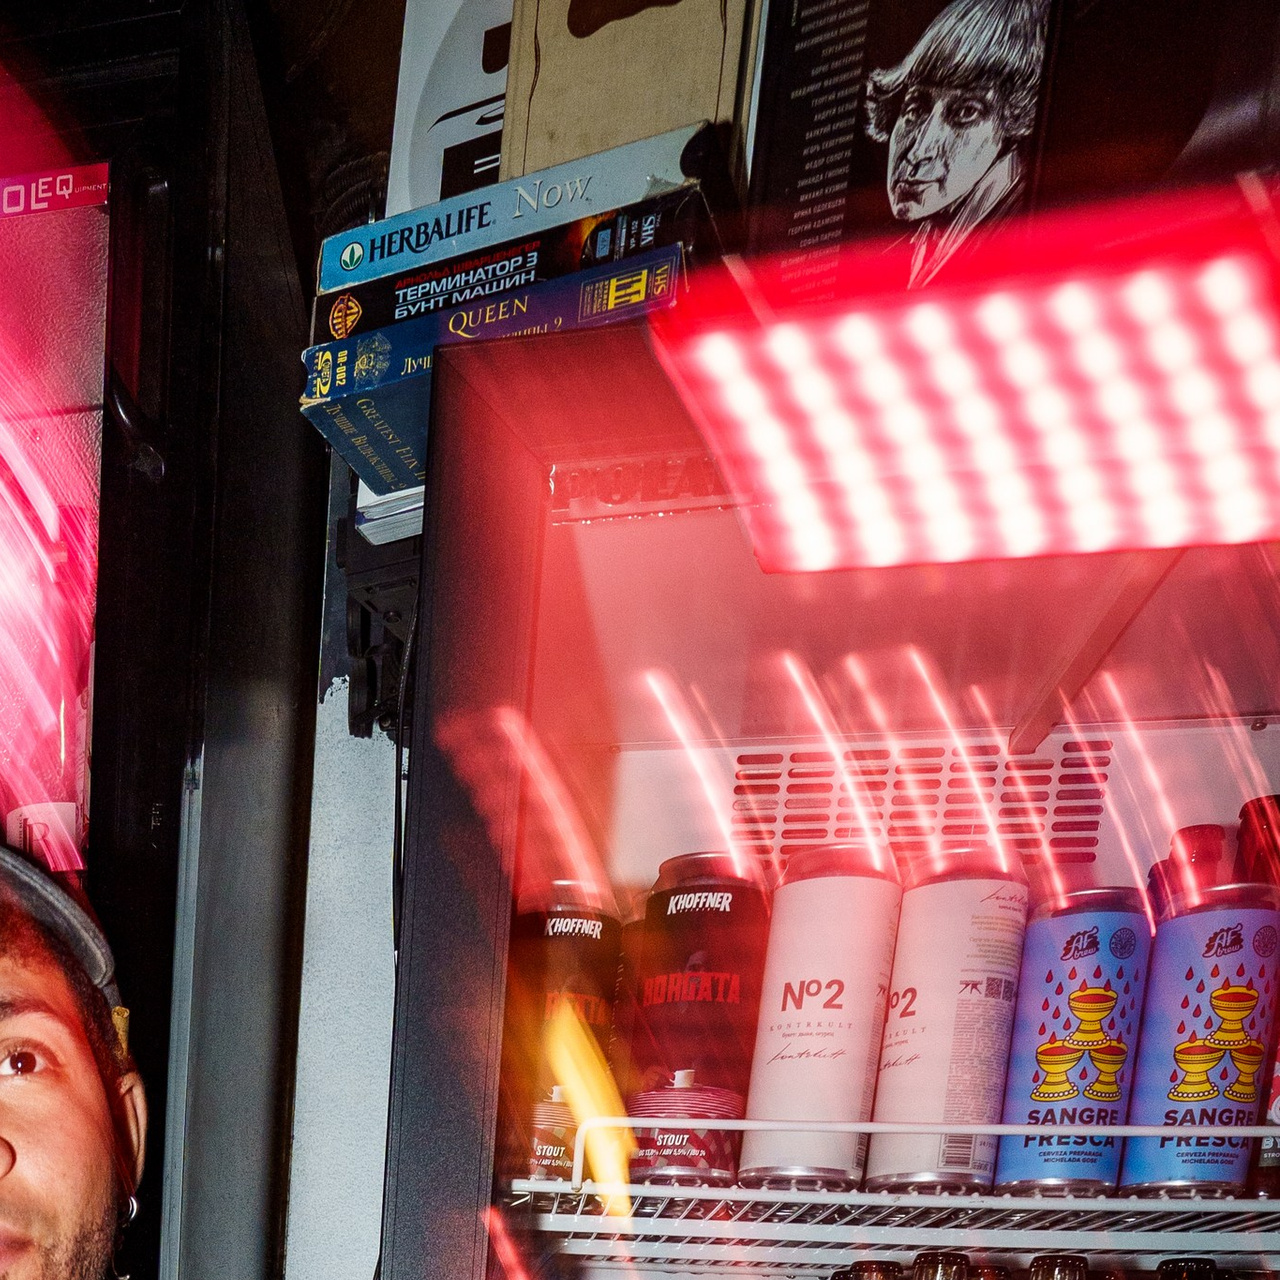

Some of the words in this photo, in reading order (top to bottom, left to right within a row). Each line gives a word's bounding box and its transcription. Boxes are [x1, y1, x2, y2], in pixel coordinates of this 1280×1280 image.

[370, 202, 492, 263] HERBALIFE
[640, 214, 656, 247] VHS
[395, 258, 522, 304] ТЕРМИНАТОР
[526, 251, 538, 268] 3
[395, 296, 450, 320] БУНТ
[452, 269, 535, 304] МАШИН
[448, 296, 528, 338] QUEEN
[667, 892, 733, 914] KHOFFNER
[544, 918, 603, 940] KHOFFNER
[1026, 1107, 1118, 1125] SANGRE
[1163, 1108, 1254, 1126] SANGRE
[536, 1145, 565, 1157] STOUT
[657, 1134, 689, 1146] STOUT
